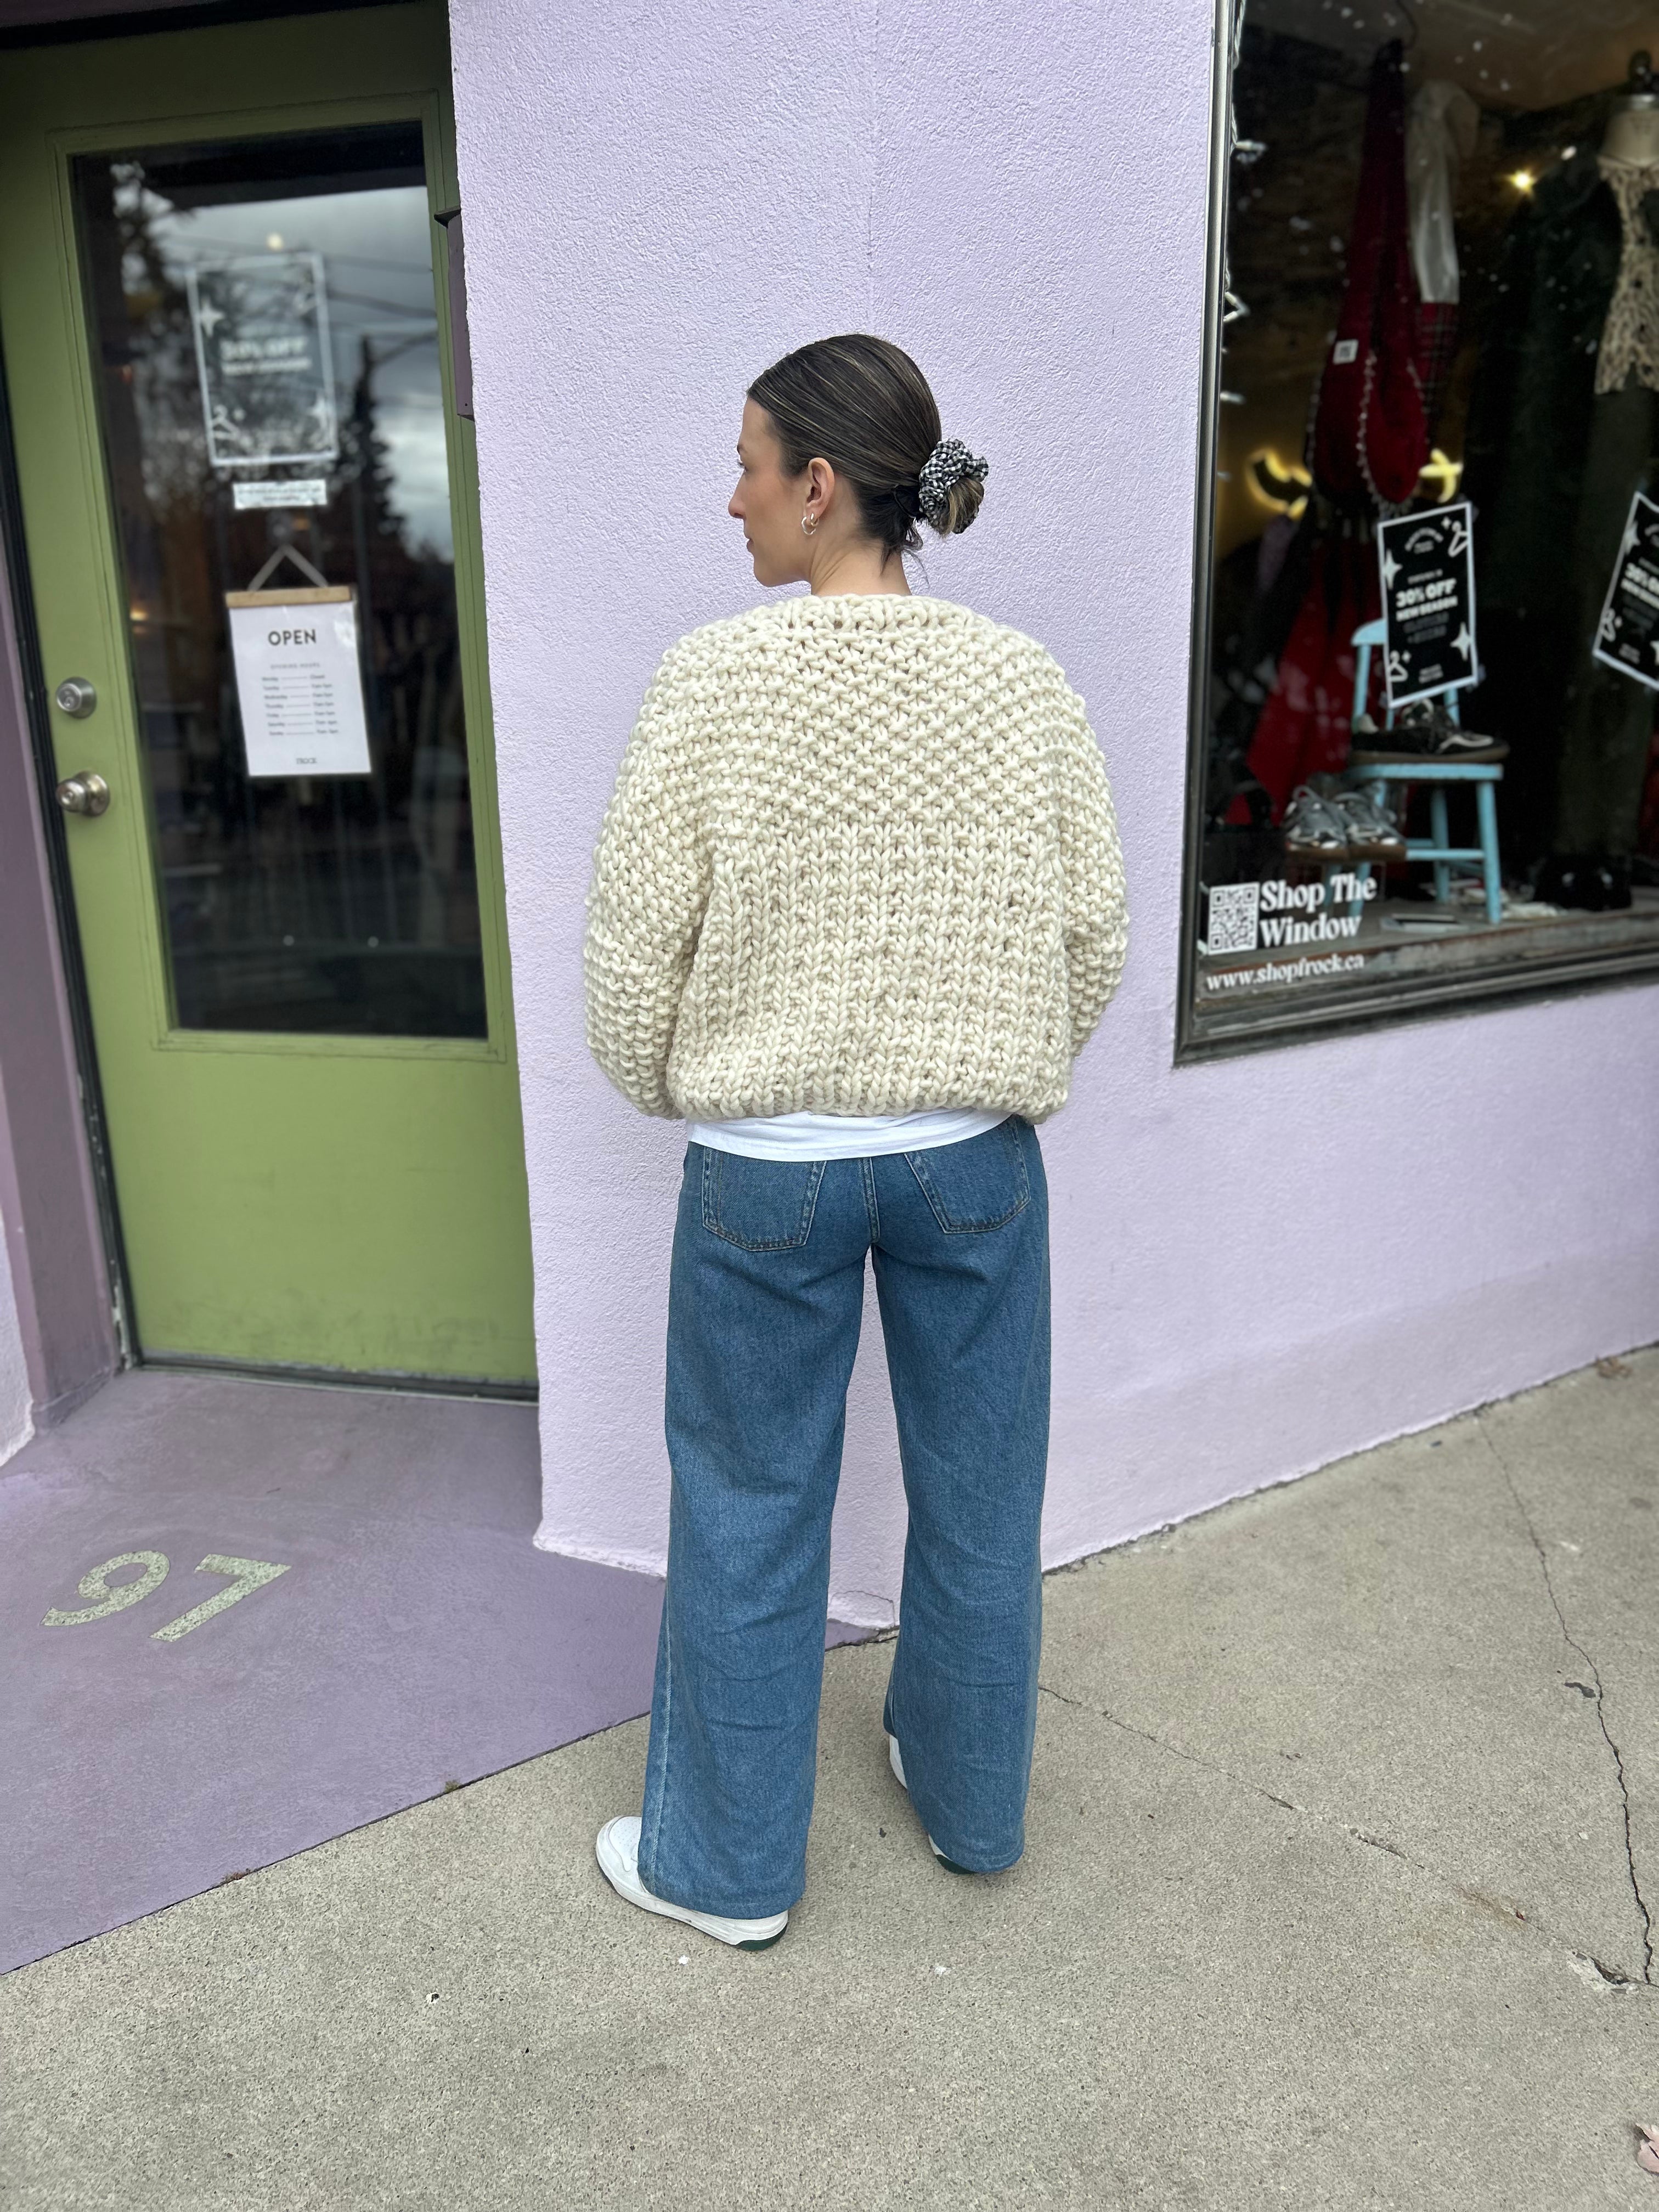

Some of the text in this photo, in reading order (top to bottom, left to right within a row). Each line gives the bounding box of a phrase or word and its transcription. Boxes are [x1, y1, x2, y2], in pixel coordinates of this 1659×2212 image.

[1396, 578, 1457, 608] 30% OFF
[268, 629, 317, 646] OPEN
[1260, 872, 1377, 913] Shop The
[1260, 912, 1362, 947] Window
[1206, 953, 1364, 990] www.shopfrock.ca
[40, 1550, 292, 1642] 97
